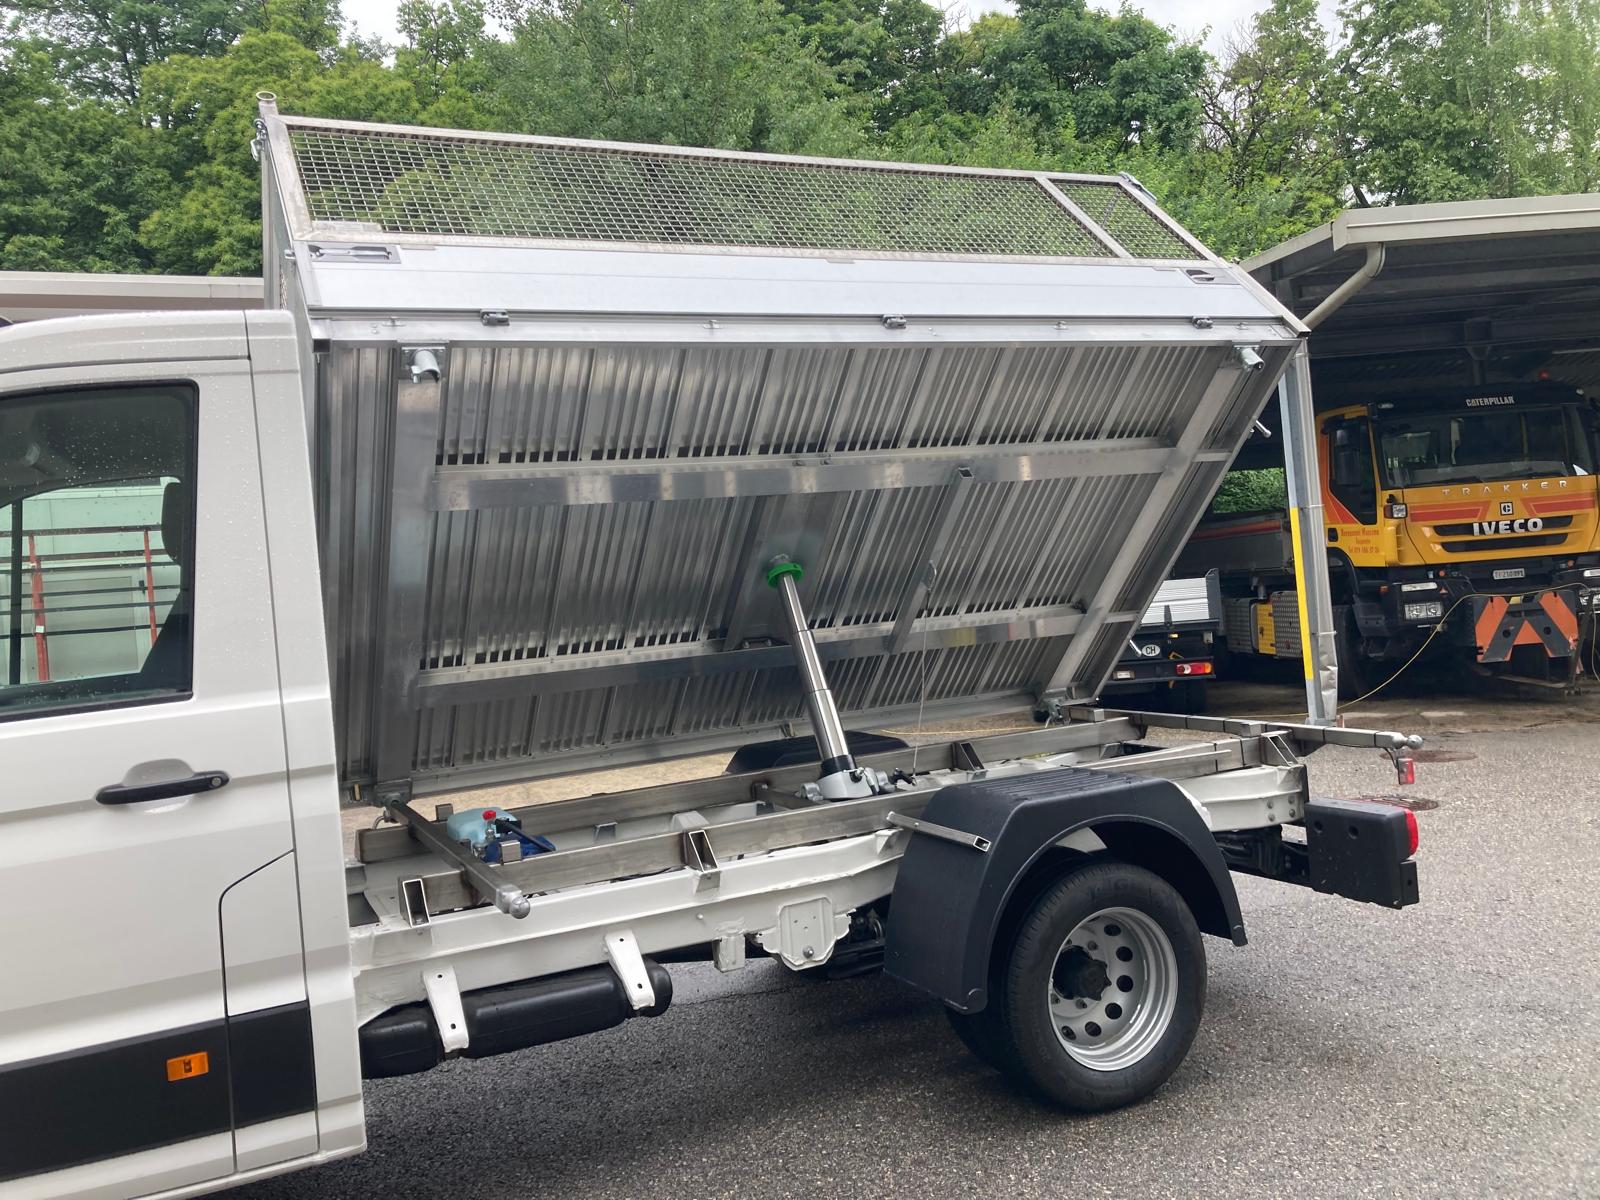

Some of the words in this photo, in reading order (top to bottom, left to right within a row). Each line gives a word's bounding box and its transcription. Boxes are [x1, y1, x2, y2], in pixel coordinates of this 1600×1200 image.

[1465, 396, 1515, 407] CATERPILLAR
[1442, 480, 1567, 495] TRAKKER
[1473, 518, 1543, 536] IVECO
[1145, 646, 1156, 655] CH
